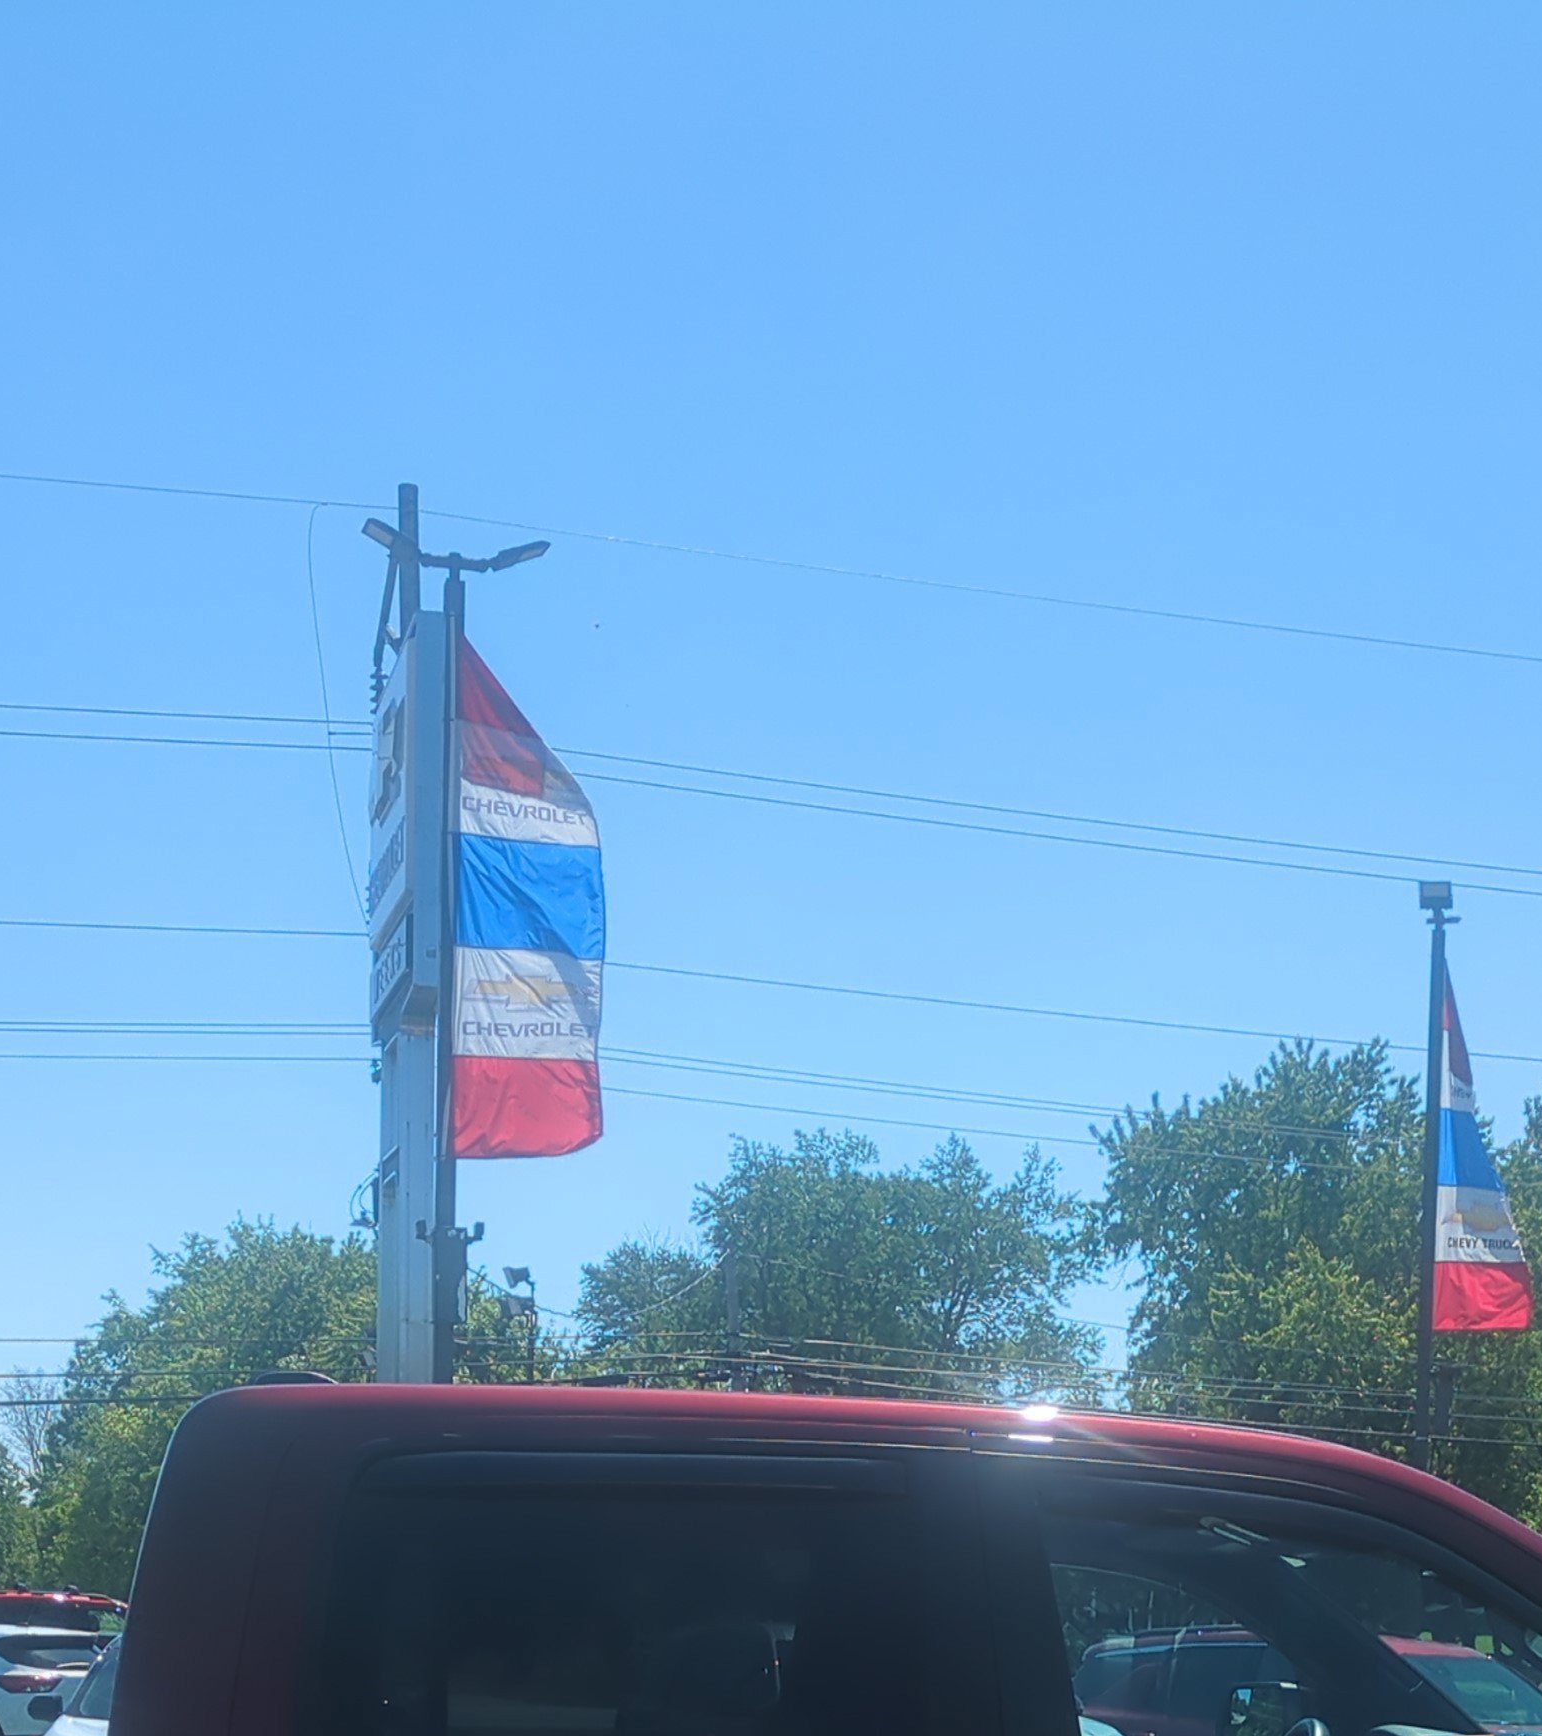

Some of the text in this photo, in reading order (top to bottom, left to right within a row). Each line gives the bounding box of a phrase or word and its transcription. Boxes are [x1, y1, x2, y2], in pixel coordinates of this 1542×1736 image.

[462, 796, 587, 825] CHEVROLET
[462, 1021, 594, 1038] CHEVROLET
[1447, 1237, 1479, 1249] CHEVY
